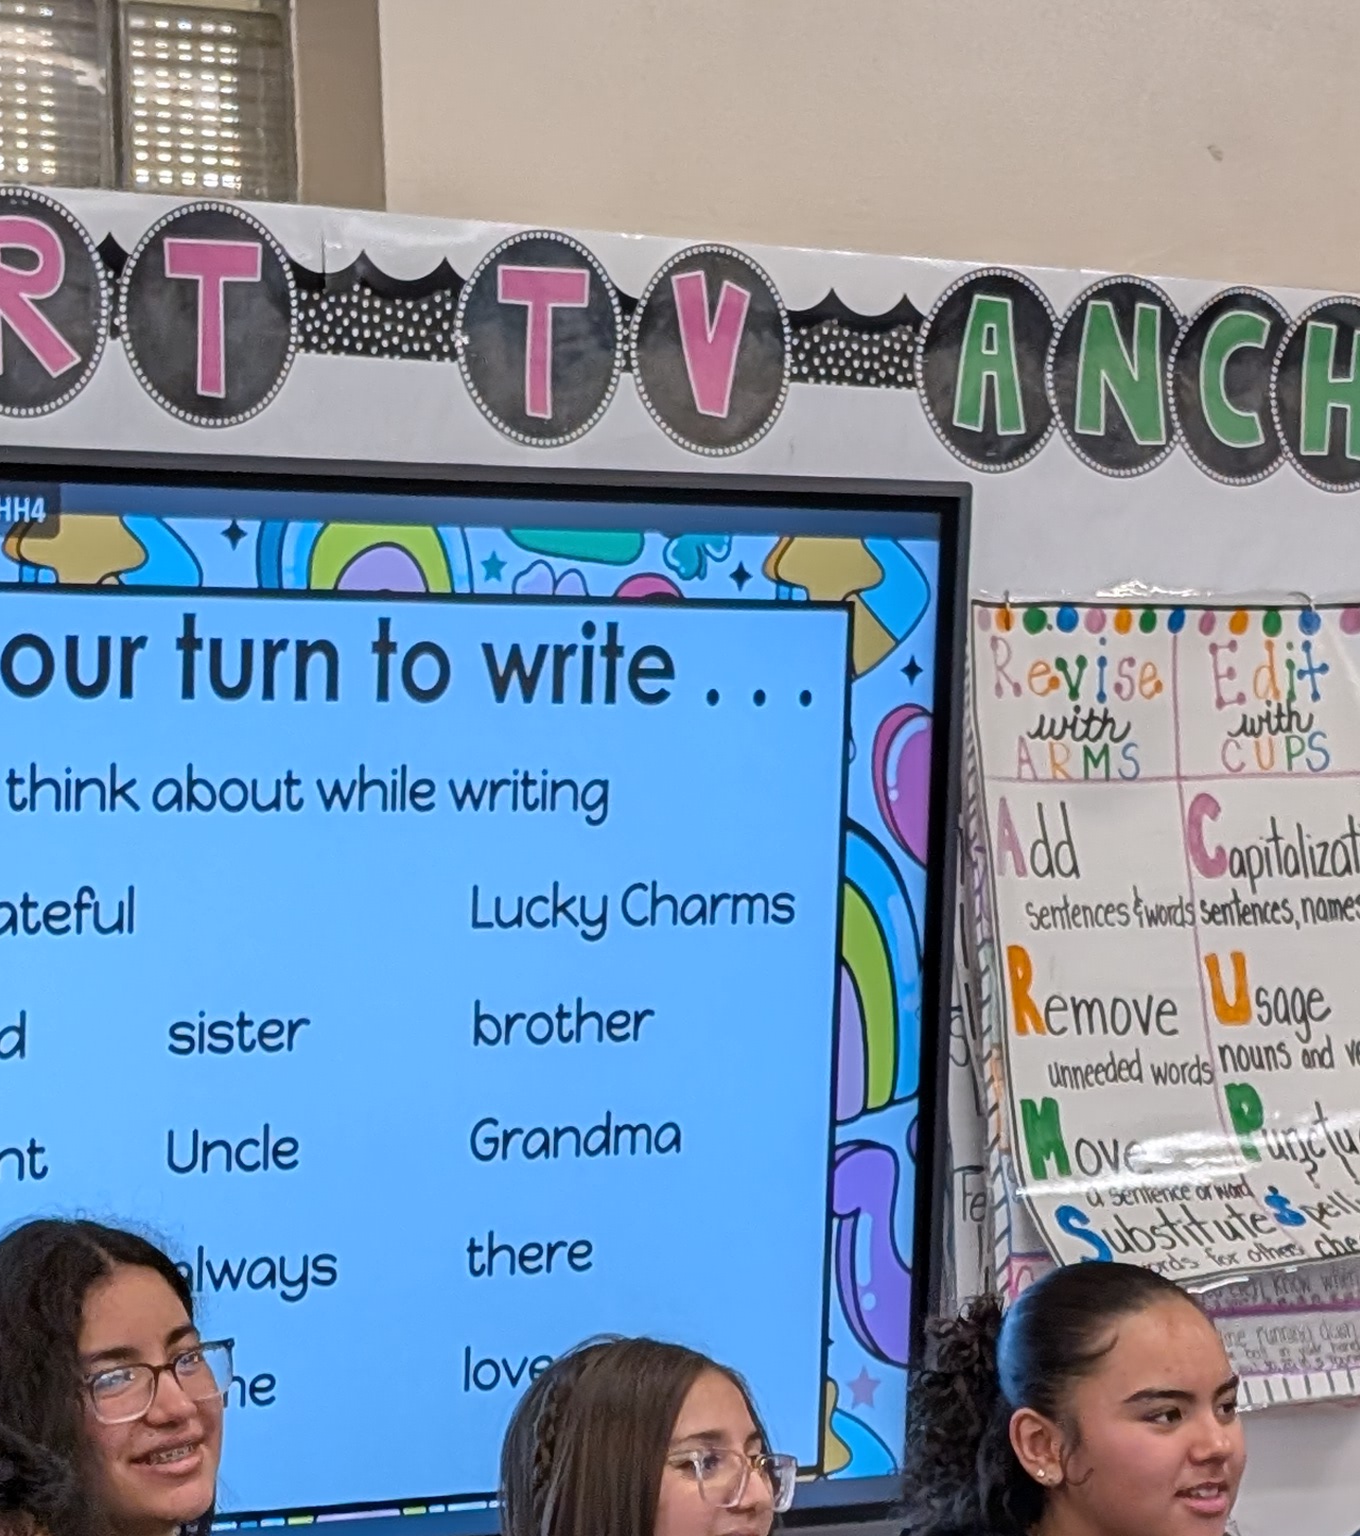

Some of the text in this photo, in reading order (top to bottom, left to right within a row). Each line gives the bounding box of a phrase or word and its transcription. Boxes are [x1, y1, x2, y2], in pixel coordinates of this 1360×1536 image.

[497, 265, 750, 419] TV
[176, 612, 339, 702] turn
[372, 617, 450, 703] to
[481, 621, 675, 705] write
[990, 635, 1163, 703] Revise
[1208, 639, 1330, 709] Edit
[1027, 705, 1131, 743] with
[1227, 701, 1314, 738] with
[1016, 736, 1140, 781] ARMS
[1221, 731, 1330, 772] CUPS
[6, 762, 139, 814] think
[151, 762, 303, 813] about
[316, 764, 436, 813] while
[448, 769, 610, 825] writing
[996, 796, 1081, 879] Add
[470, 882, 796, 941] Lucky Charms
[1144, 894, 1196, 929] words
[1006, 944, 1179, 1037] Remove
[1204, 951, 1331, 1044] Usage
[168, 1011, 310, 1056] sister
[473, 997, 656, 1046] brother
[1048, 1048, 1215, 1091] unneeded words
[1218, 1042, 1292, 1075] nouns
[1301, 1035, 1335, 1070] and
[167, 1123, 300, 1175] Uncle
[470, 1112, 682, 1162] Grandma
[1020, 1096, 1150, 1181] Move
[466, 1231, 593, 1278] there
[1055, 1203, 1269, 1262] Substitute
[1140, 1252, 1199, 1275] ords
